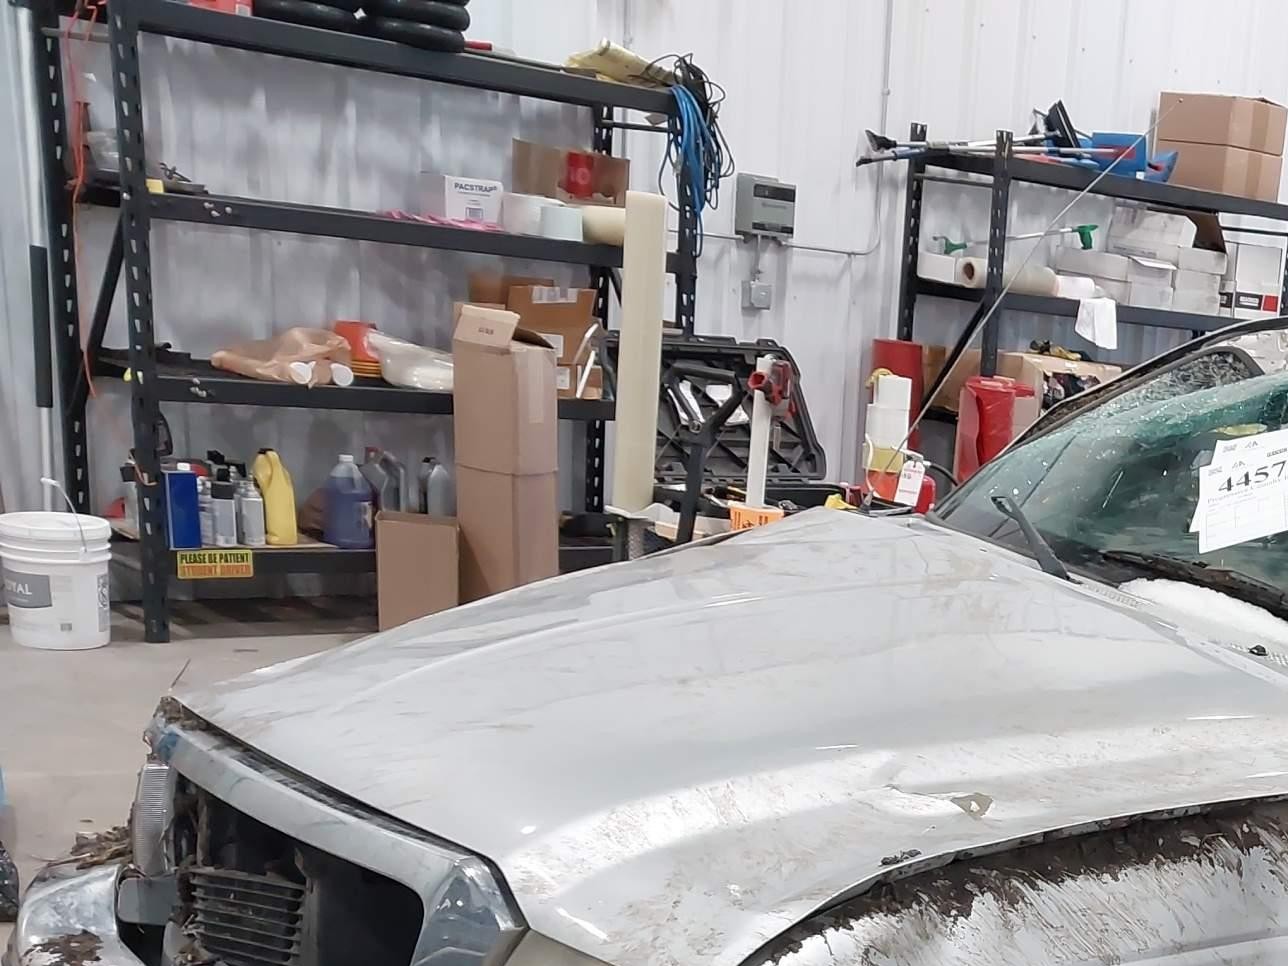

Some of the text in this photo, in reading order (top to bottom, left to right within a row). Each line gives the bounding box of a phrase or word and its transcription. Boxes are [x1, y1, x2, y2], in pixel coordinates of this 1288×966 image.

[180, 552, 249, 564] PLEASE BE PATIENT
